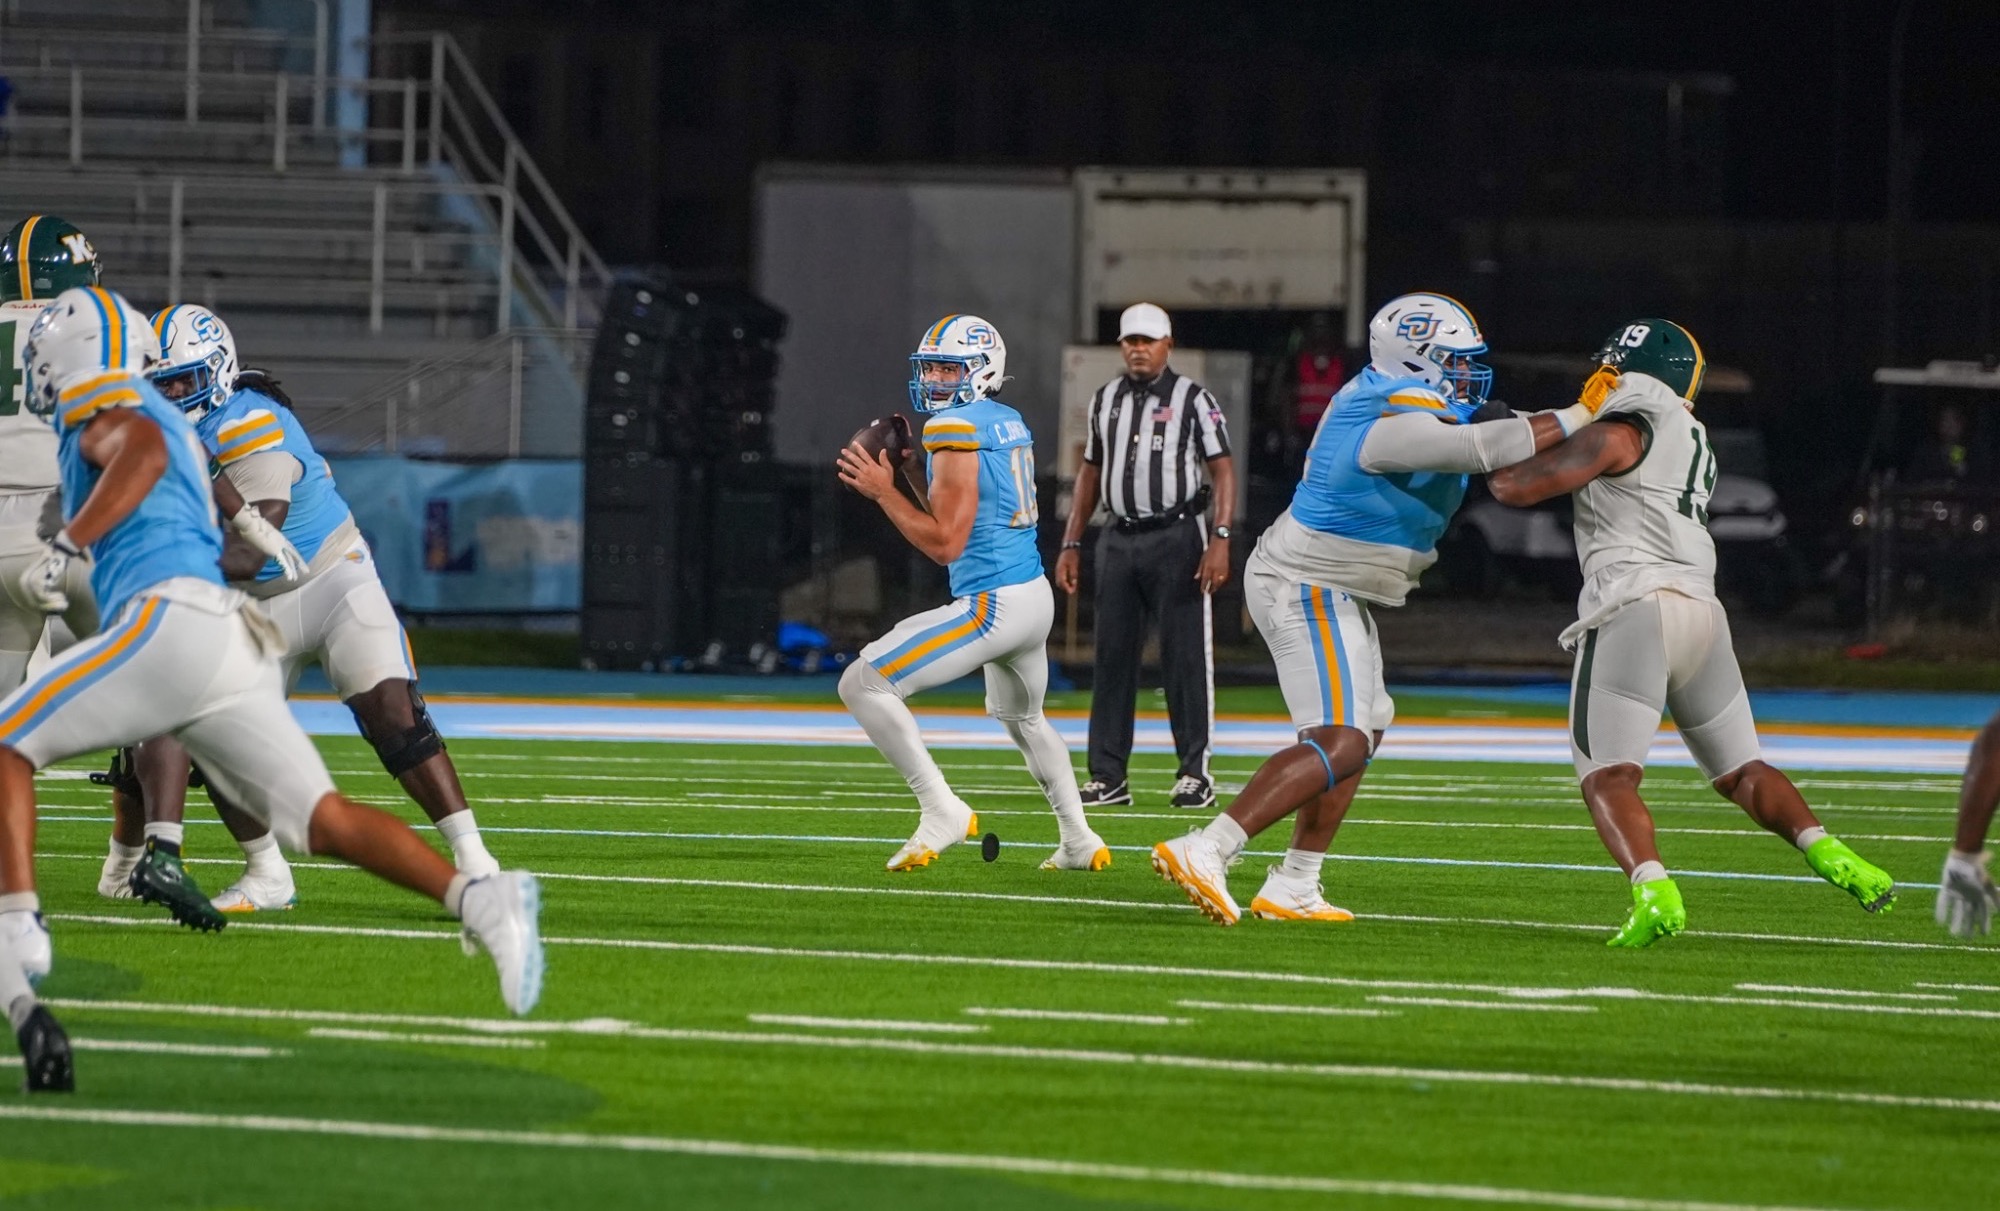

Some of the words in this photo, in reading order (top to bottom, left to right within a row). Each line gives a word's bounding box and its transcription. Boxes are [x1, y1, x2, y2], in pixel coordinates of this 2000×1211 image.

[966, 324, 997, 350] SU
[1396, 311, 1443, 341] SU
[1618, 325, 1651, 348] 19
[1152, 434, 1164, 451] R
[1677, 426, 1718, 528] 19
